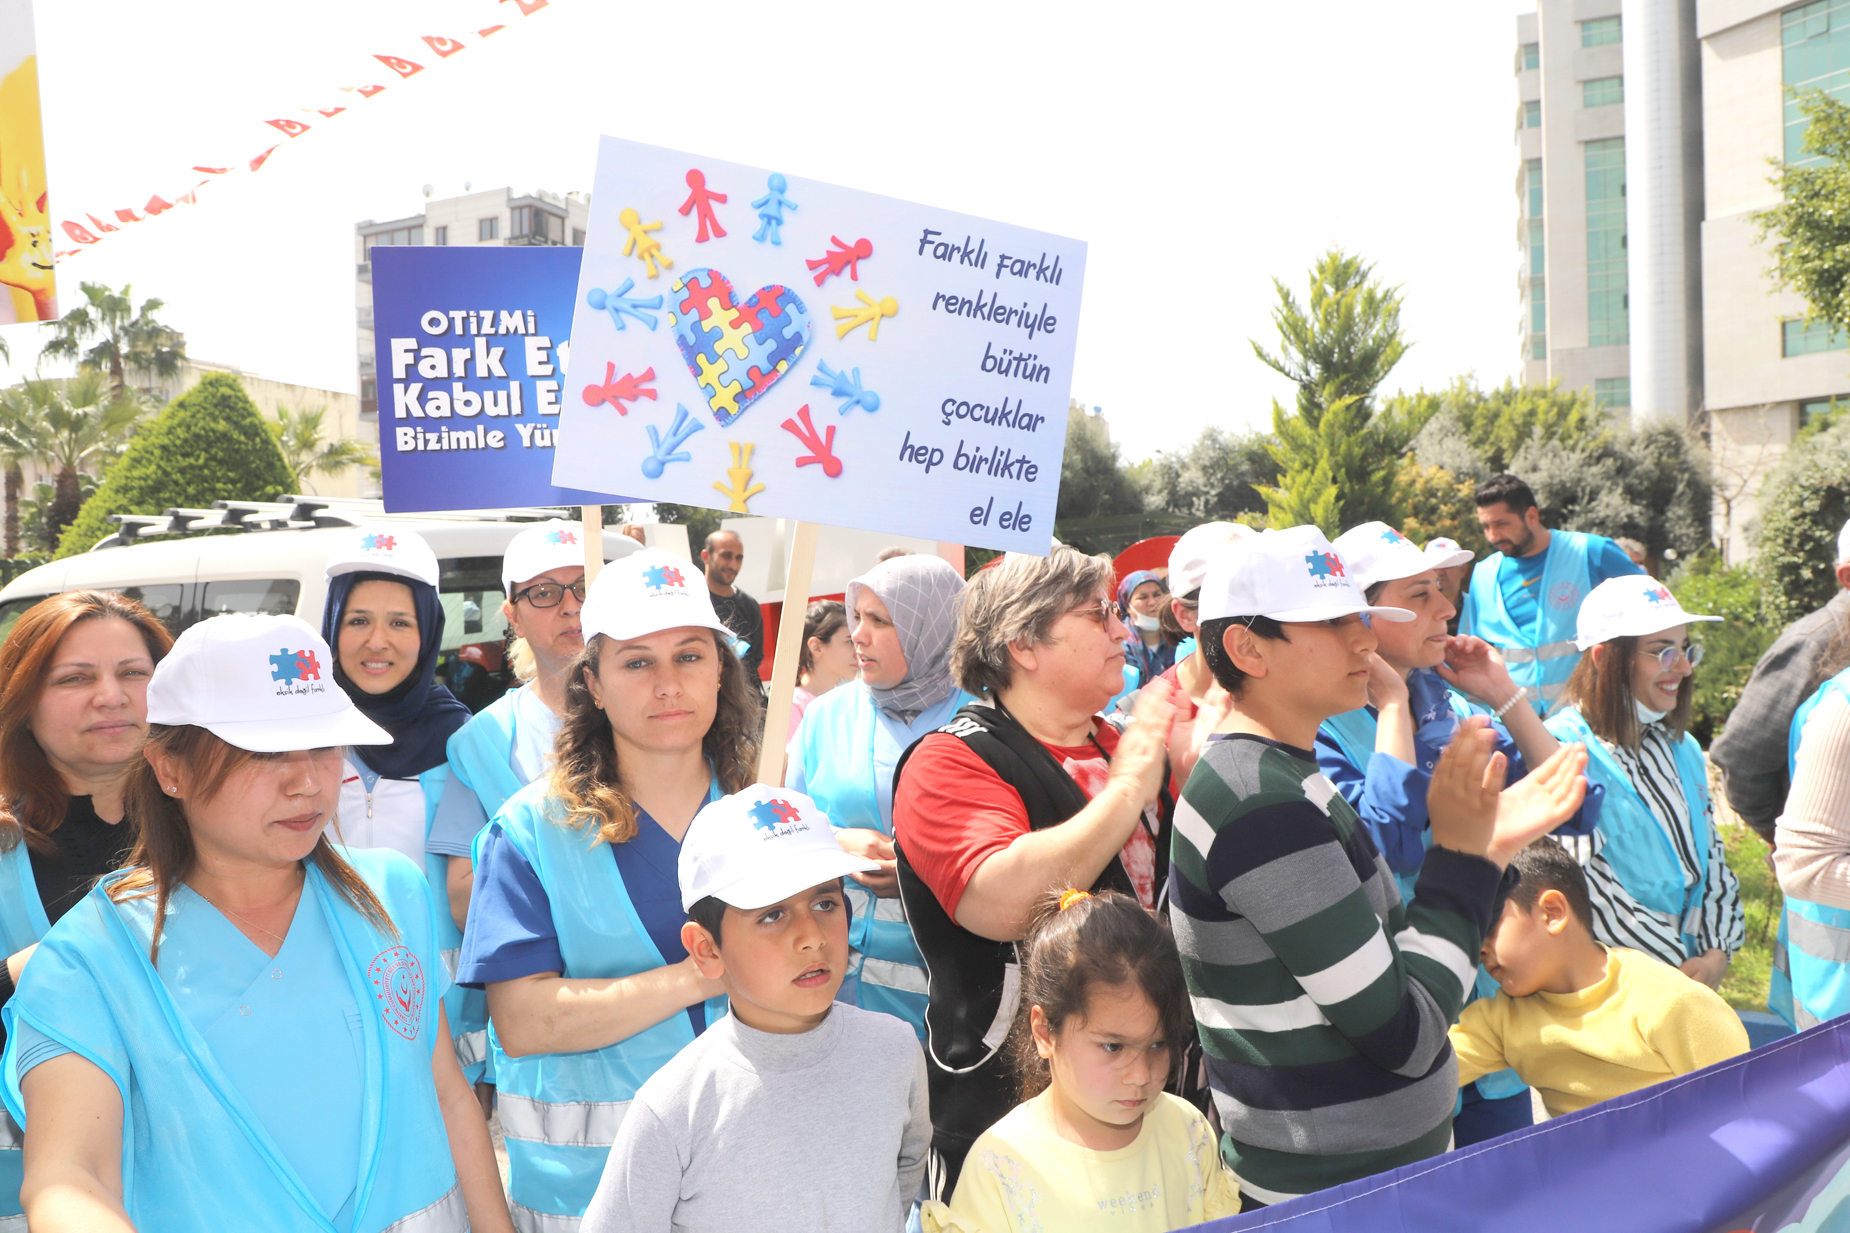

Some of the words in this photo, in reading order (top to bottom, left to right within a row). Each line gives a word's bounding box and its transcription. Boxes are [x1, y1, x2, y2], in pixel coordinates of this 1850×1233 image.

[918, 228, 988, 269] Farklı
[932, 289, 1057, 340] renkleriyle
[390, 336, 508, 379] Fark
[980, 341, 1050, 384] bütün
[393, 380, 522, 418] Kabul
[535, 380, 563, 415] E
[941, 396, 1045, 432] çocuklar
[395, 425, 505, 451] Bizimle
[899, 430, 944, 474] hep
[953, 439, 1038, 482] birlikte
[969, 496, 994, 526] el
[999, 501, 1032, 532] ele
[1097, 1183, 1161, 1210] weekend
